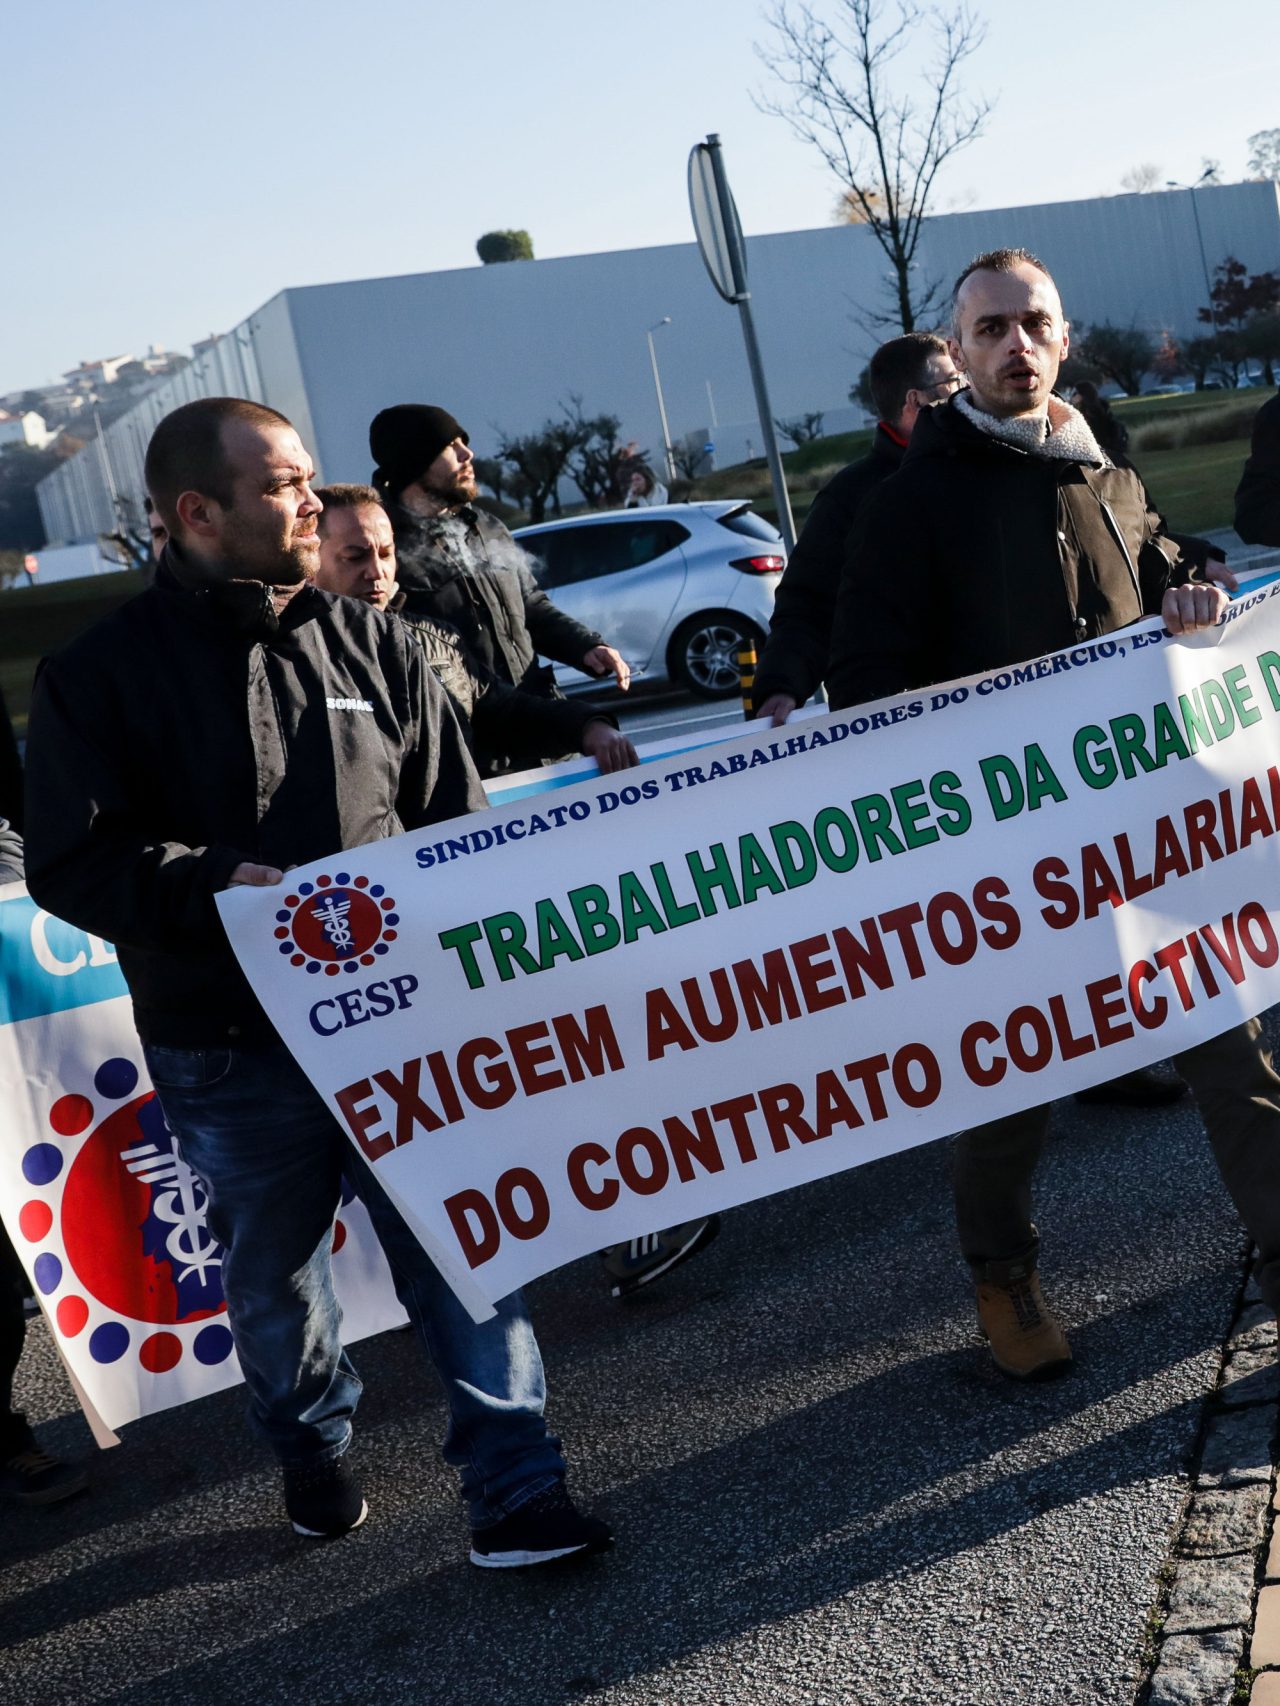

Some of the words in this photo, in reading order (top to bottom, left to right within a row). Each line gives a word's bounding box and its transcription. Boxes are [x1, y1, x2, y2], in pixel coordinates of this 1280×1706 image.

[415, 801, 591, 868] SINDICATO
[596, 780, 660, 814] DOS
[664, 701, 924, 792] TRABALHADORES
[930, 687, 969, 712] DO
[975, 640, 1126, 697] COMÉRCIO,
[438, 771, 973, 990] TRABALHADORES
[978, 744, 1069, 823] DA
[1073, 664, 1262, 791] GRANDE
[309, 974, 419, 1037] CESP
[335, 1005, 625, 1162] EXIGEM
[646, 877, 1021, 1062] AUMENTOS
[443, 1168, 551, 1270] DO
[566, 1043, 942, 1212] CONTRATO
[961, 902, 1279, 1087] COLECTIVO
